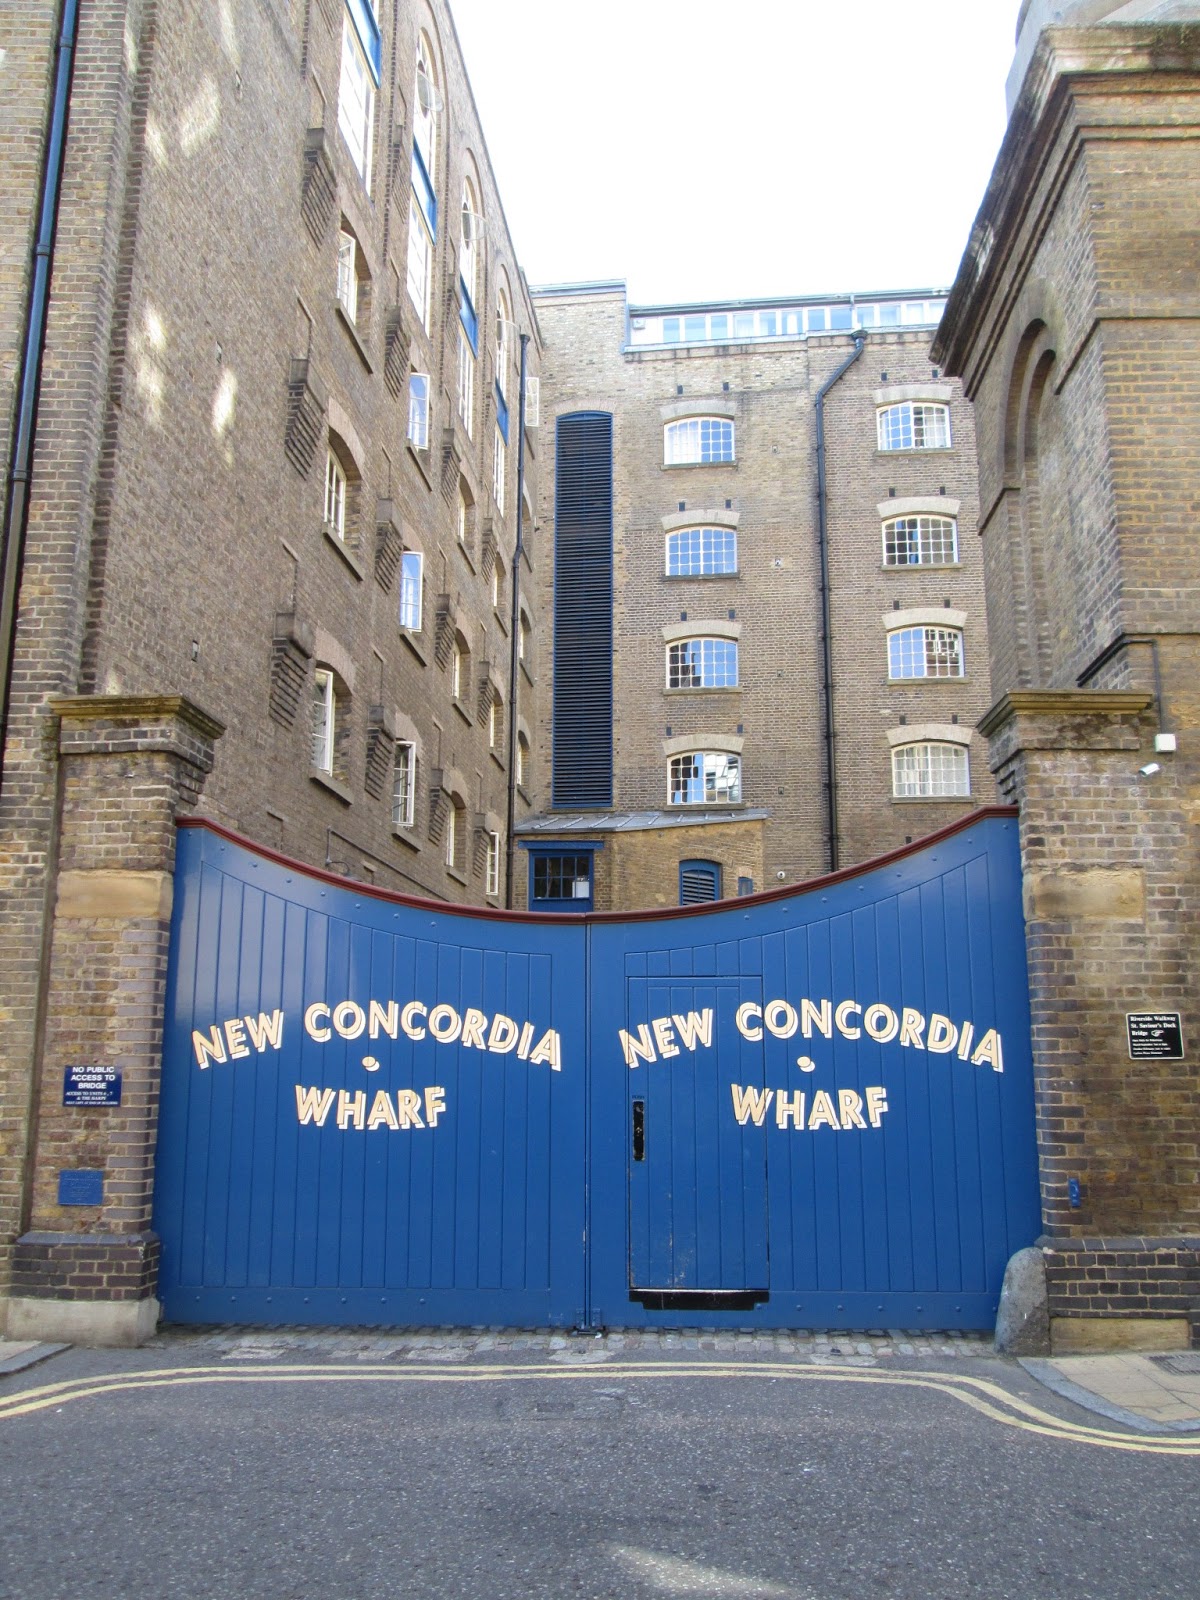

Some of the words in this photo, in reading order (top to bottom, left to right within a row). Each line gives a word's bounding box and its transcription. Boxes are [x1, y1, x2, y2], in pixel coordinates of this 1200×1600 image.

[191, 1009, 284, 1070] NEW
[304, 1000, 562, 1071] CONCORDIA
[618, 1008, 713, 1069] NEW
[735, 998, 1003, 1073] CONCORDIA
[294, 1084, 446, 1130] WHARF
[731, 1083, 888, 1130] WHARF
